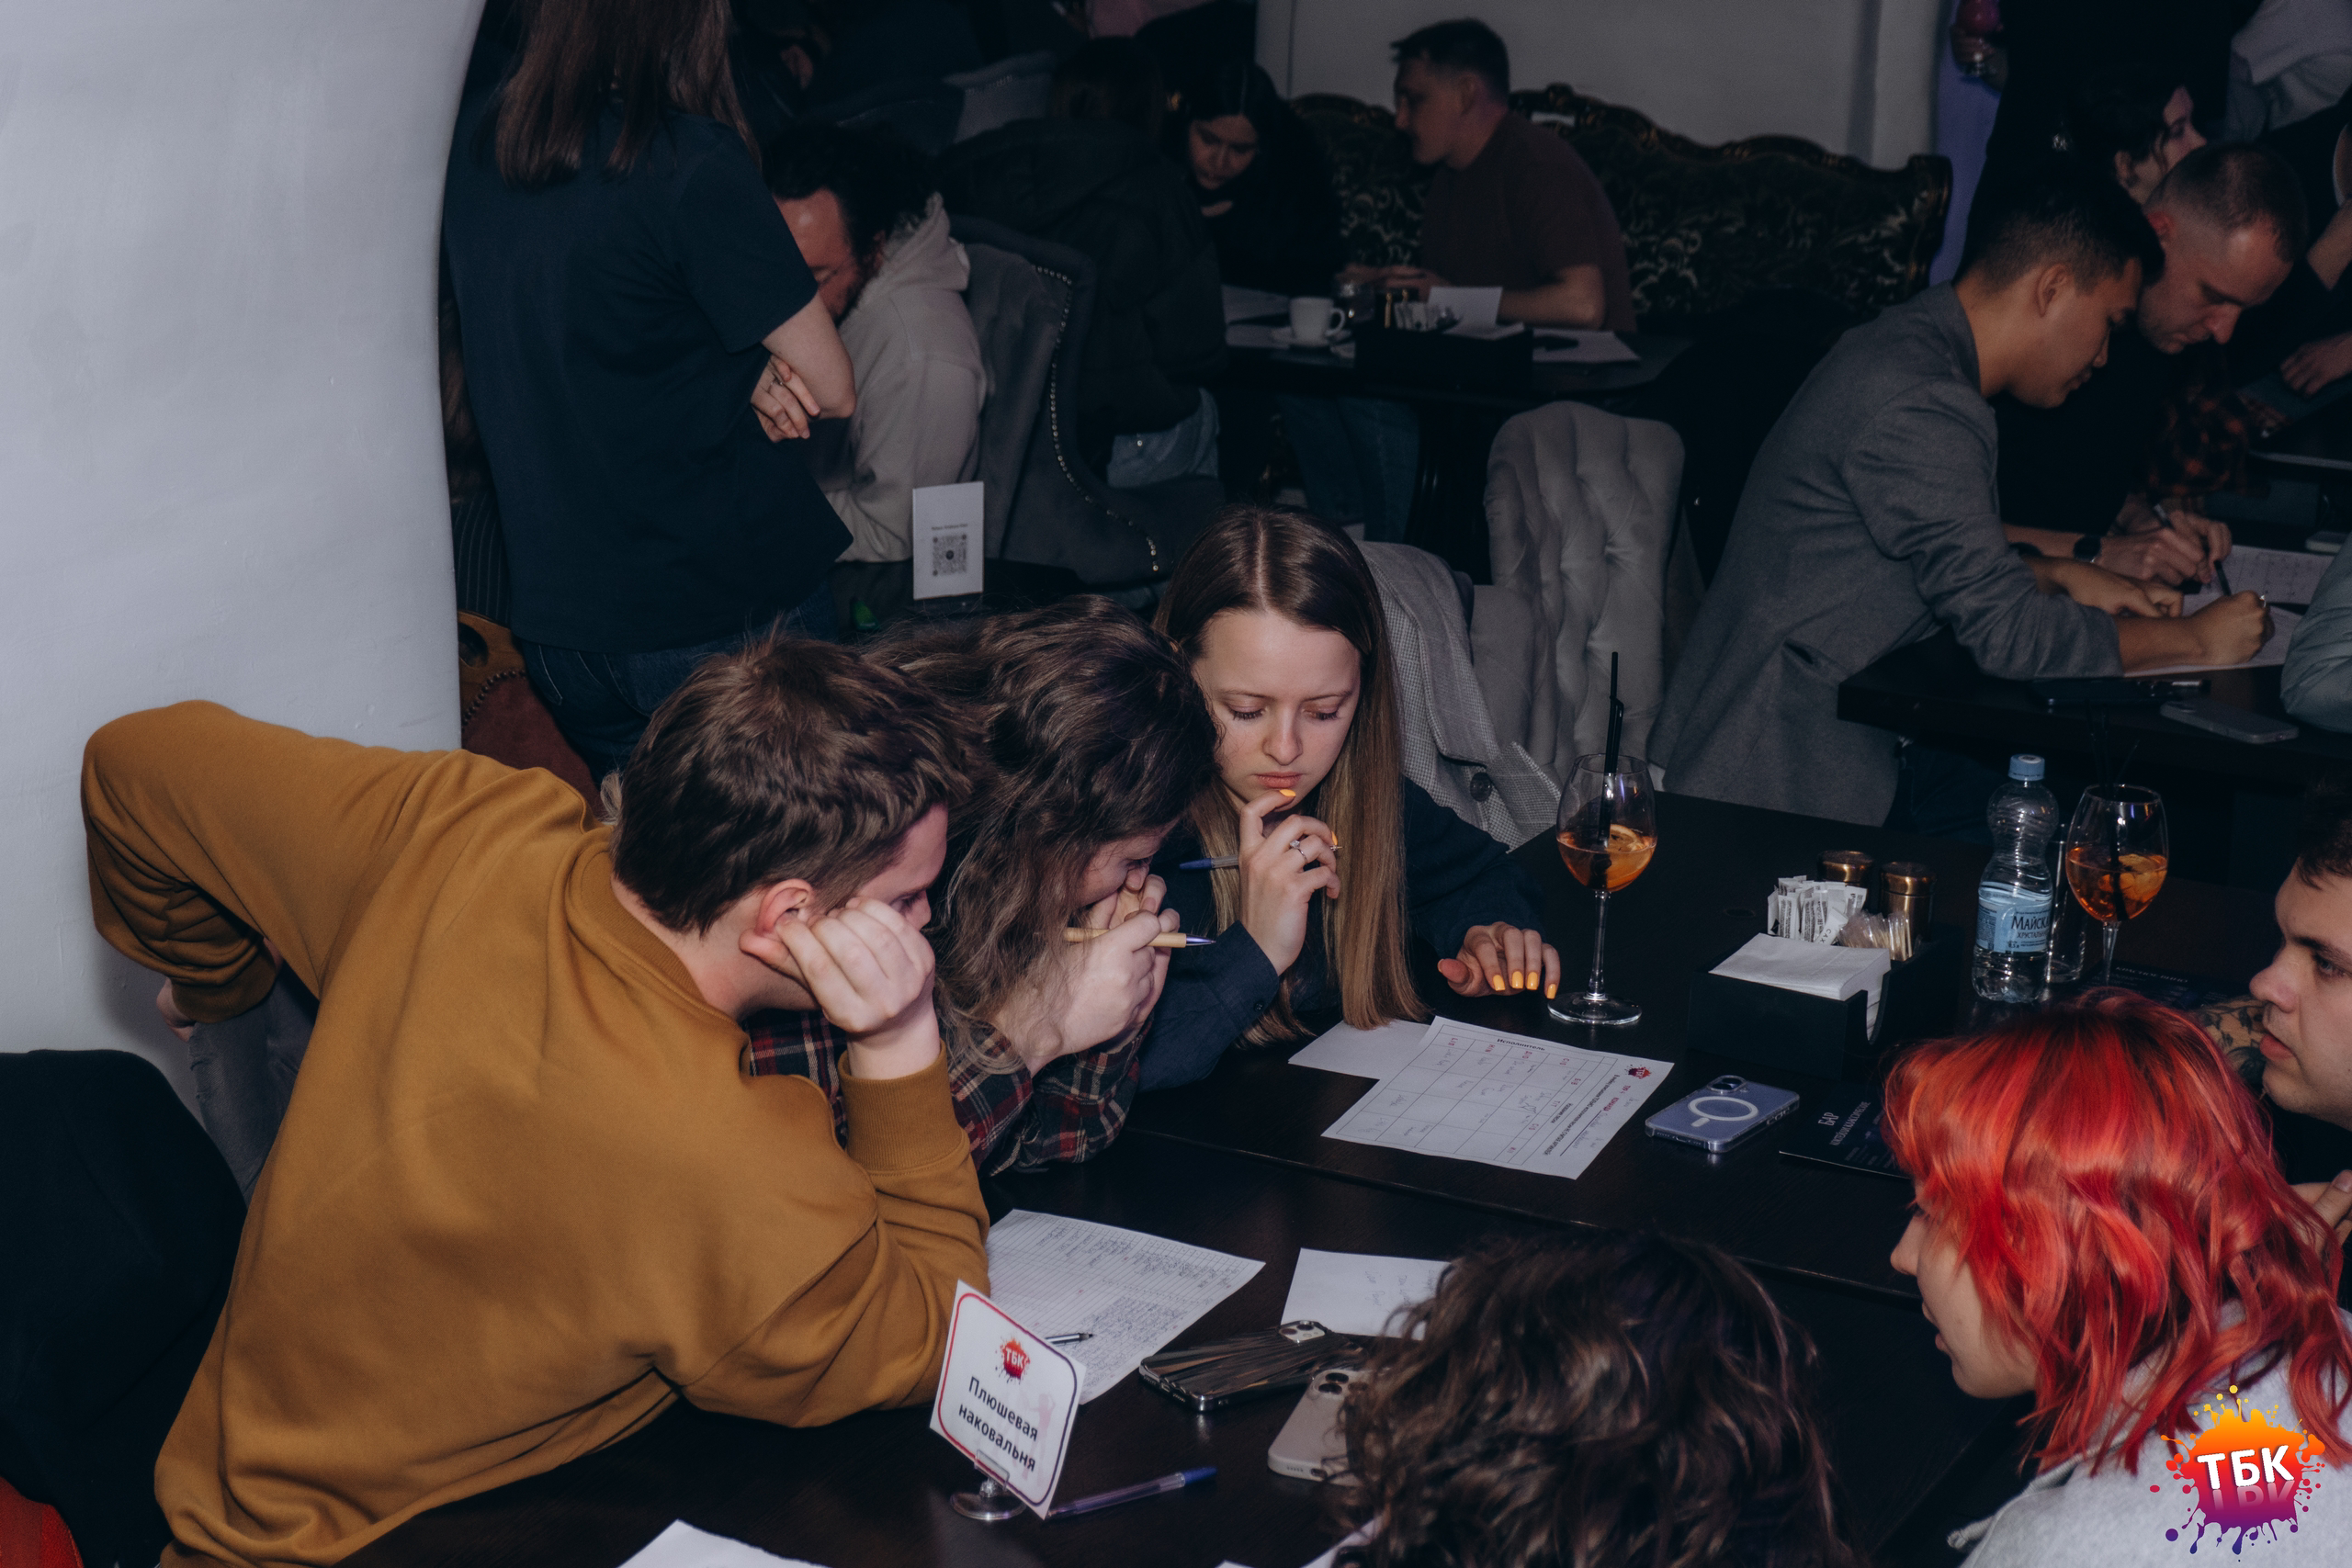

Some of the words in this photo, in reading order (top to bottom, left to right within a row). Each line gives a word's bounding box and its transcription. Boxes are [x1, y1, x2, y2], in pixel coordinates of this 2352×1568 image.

[1818, 928, 1832, 944] САХ
[1497, 1038, 1545, 1051] Исполнитель
[1818, 1112, 1838, 1125] БАР
[1005, 1348, 1024, 1368] ТБК
[968, 1376, 1038, 1441] Плюшевая
[958, 1404, 1035, 1472] наковальня
